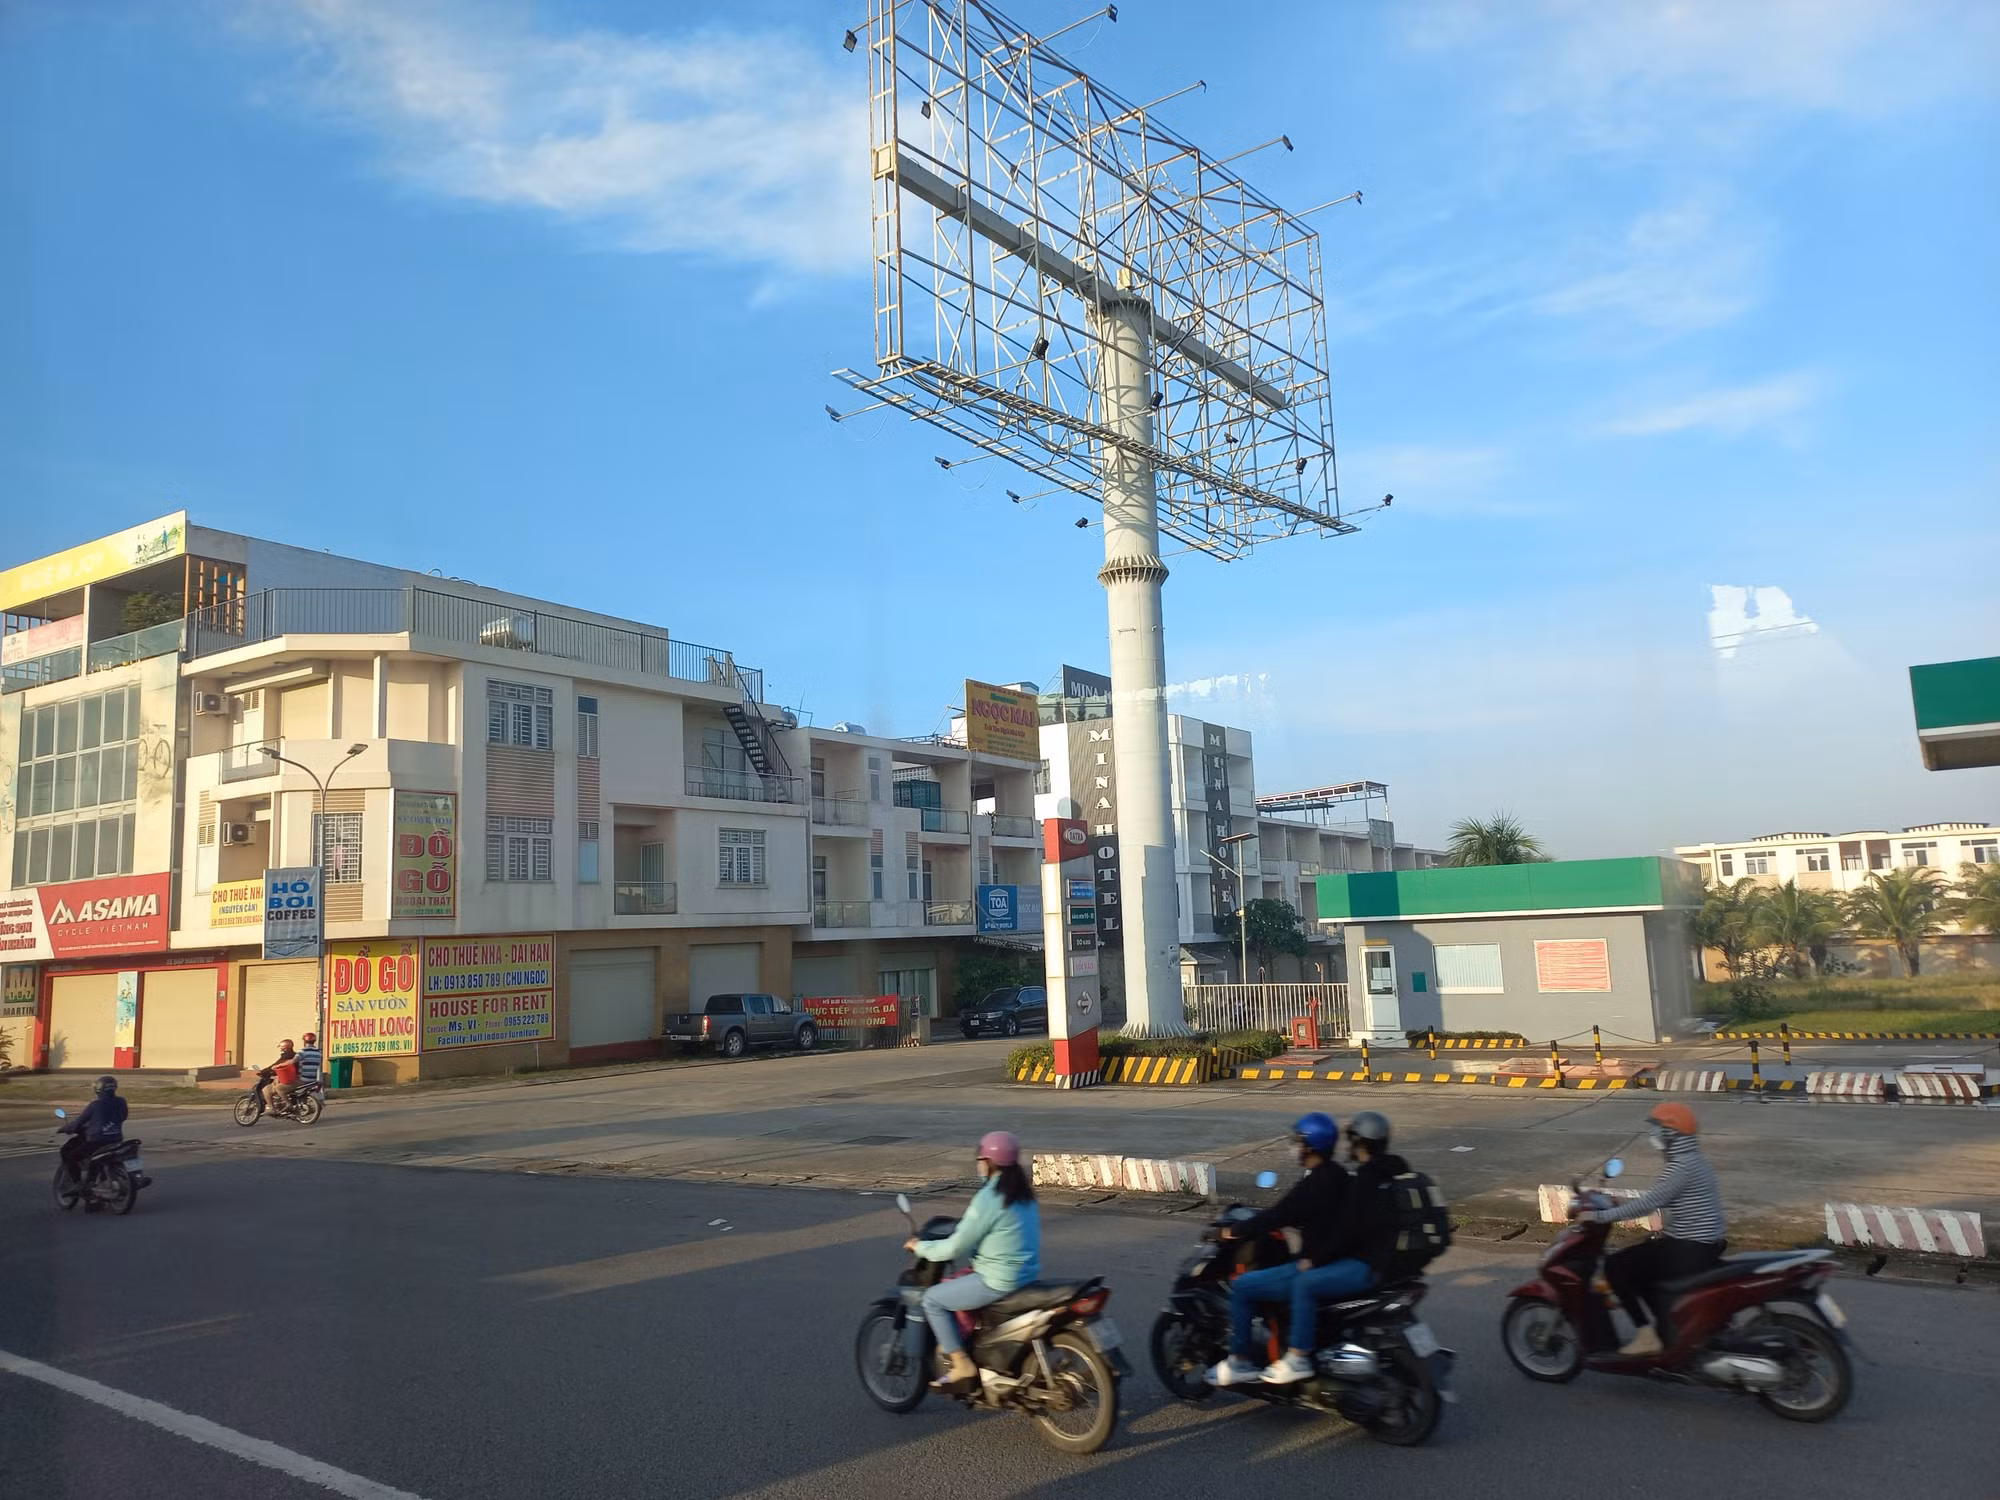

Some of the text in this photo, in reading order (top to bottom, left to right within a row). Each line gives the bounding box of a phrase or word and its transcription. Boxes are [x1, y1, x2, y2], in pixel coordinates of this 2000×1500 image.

[1010, 706, 1035, 728] MAI
[398, 861, 451, 894] GỖ
[1094, 823, 1120, 931] HOTEL
[213, 890, 228, 903] CHO
[990, 897, 1007, 908] TOA
[77, 894, 160, 922] ASAMA
[267, 909, 316, 920] COFFEE
[58, 926, 91, 938] CYCLE
[428, 946, 450, 967] CHO
[530, 943, 549, 966] HẠN
[379, 944, 415, 992] GỖ
[428, 976, 442, 990] LH:
[444, 975, 466, 990] 0913
[468, 973, 483, 988] 850
[485, 973, 500, 987] 789
[3, 1006, 34, 1015] MARTIN
[337, 997, 365, 1012] SÂN
[368, 995, 407, 1010] VƯỜN
[430, 994, 547, 1018] HOUSE FOR RENT
[830, 1005, 850, 1014] TIẾP
[883, 1004, 896, 1013] ĐÁ
[331, 1013, 414, 1040] THÀNH LONG
[448, 1021, 465, 1032] Ms.
[468, 1020, 476, 1030] VI
[504, 1017, 520, 1027] 0965
[522, 1016, 535, 1025] 222
[537, 1013, 549, 1024] 789
[438, 1035, 468, 1045] Facility:
[470, 1033, 482, 1042] full
[509, 1029, 539, 1038] furniture
[332, 1040, 412, 1054] LH: 0965 222 789 (MS. VI)
